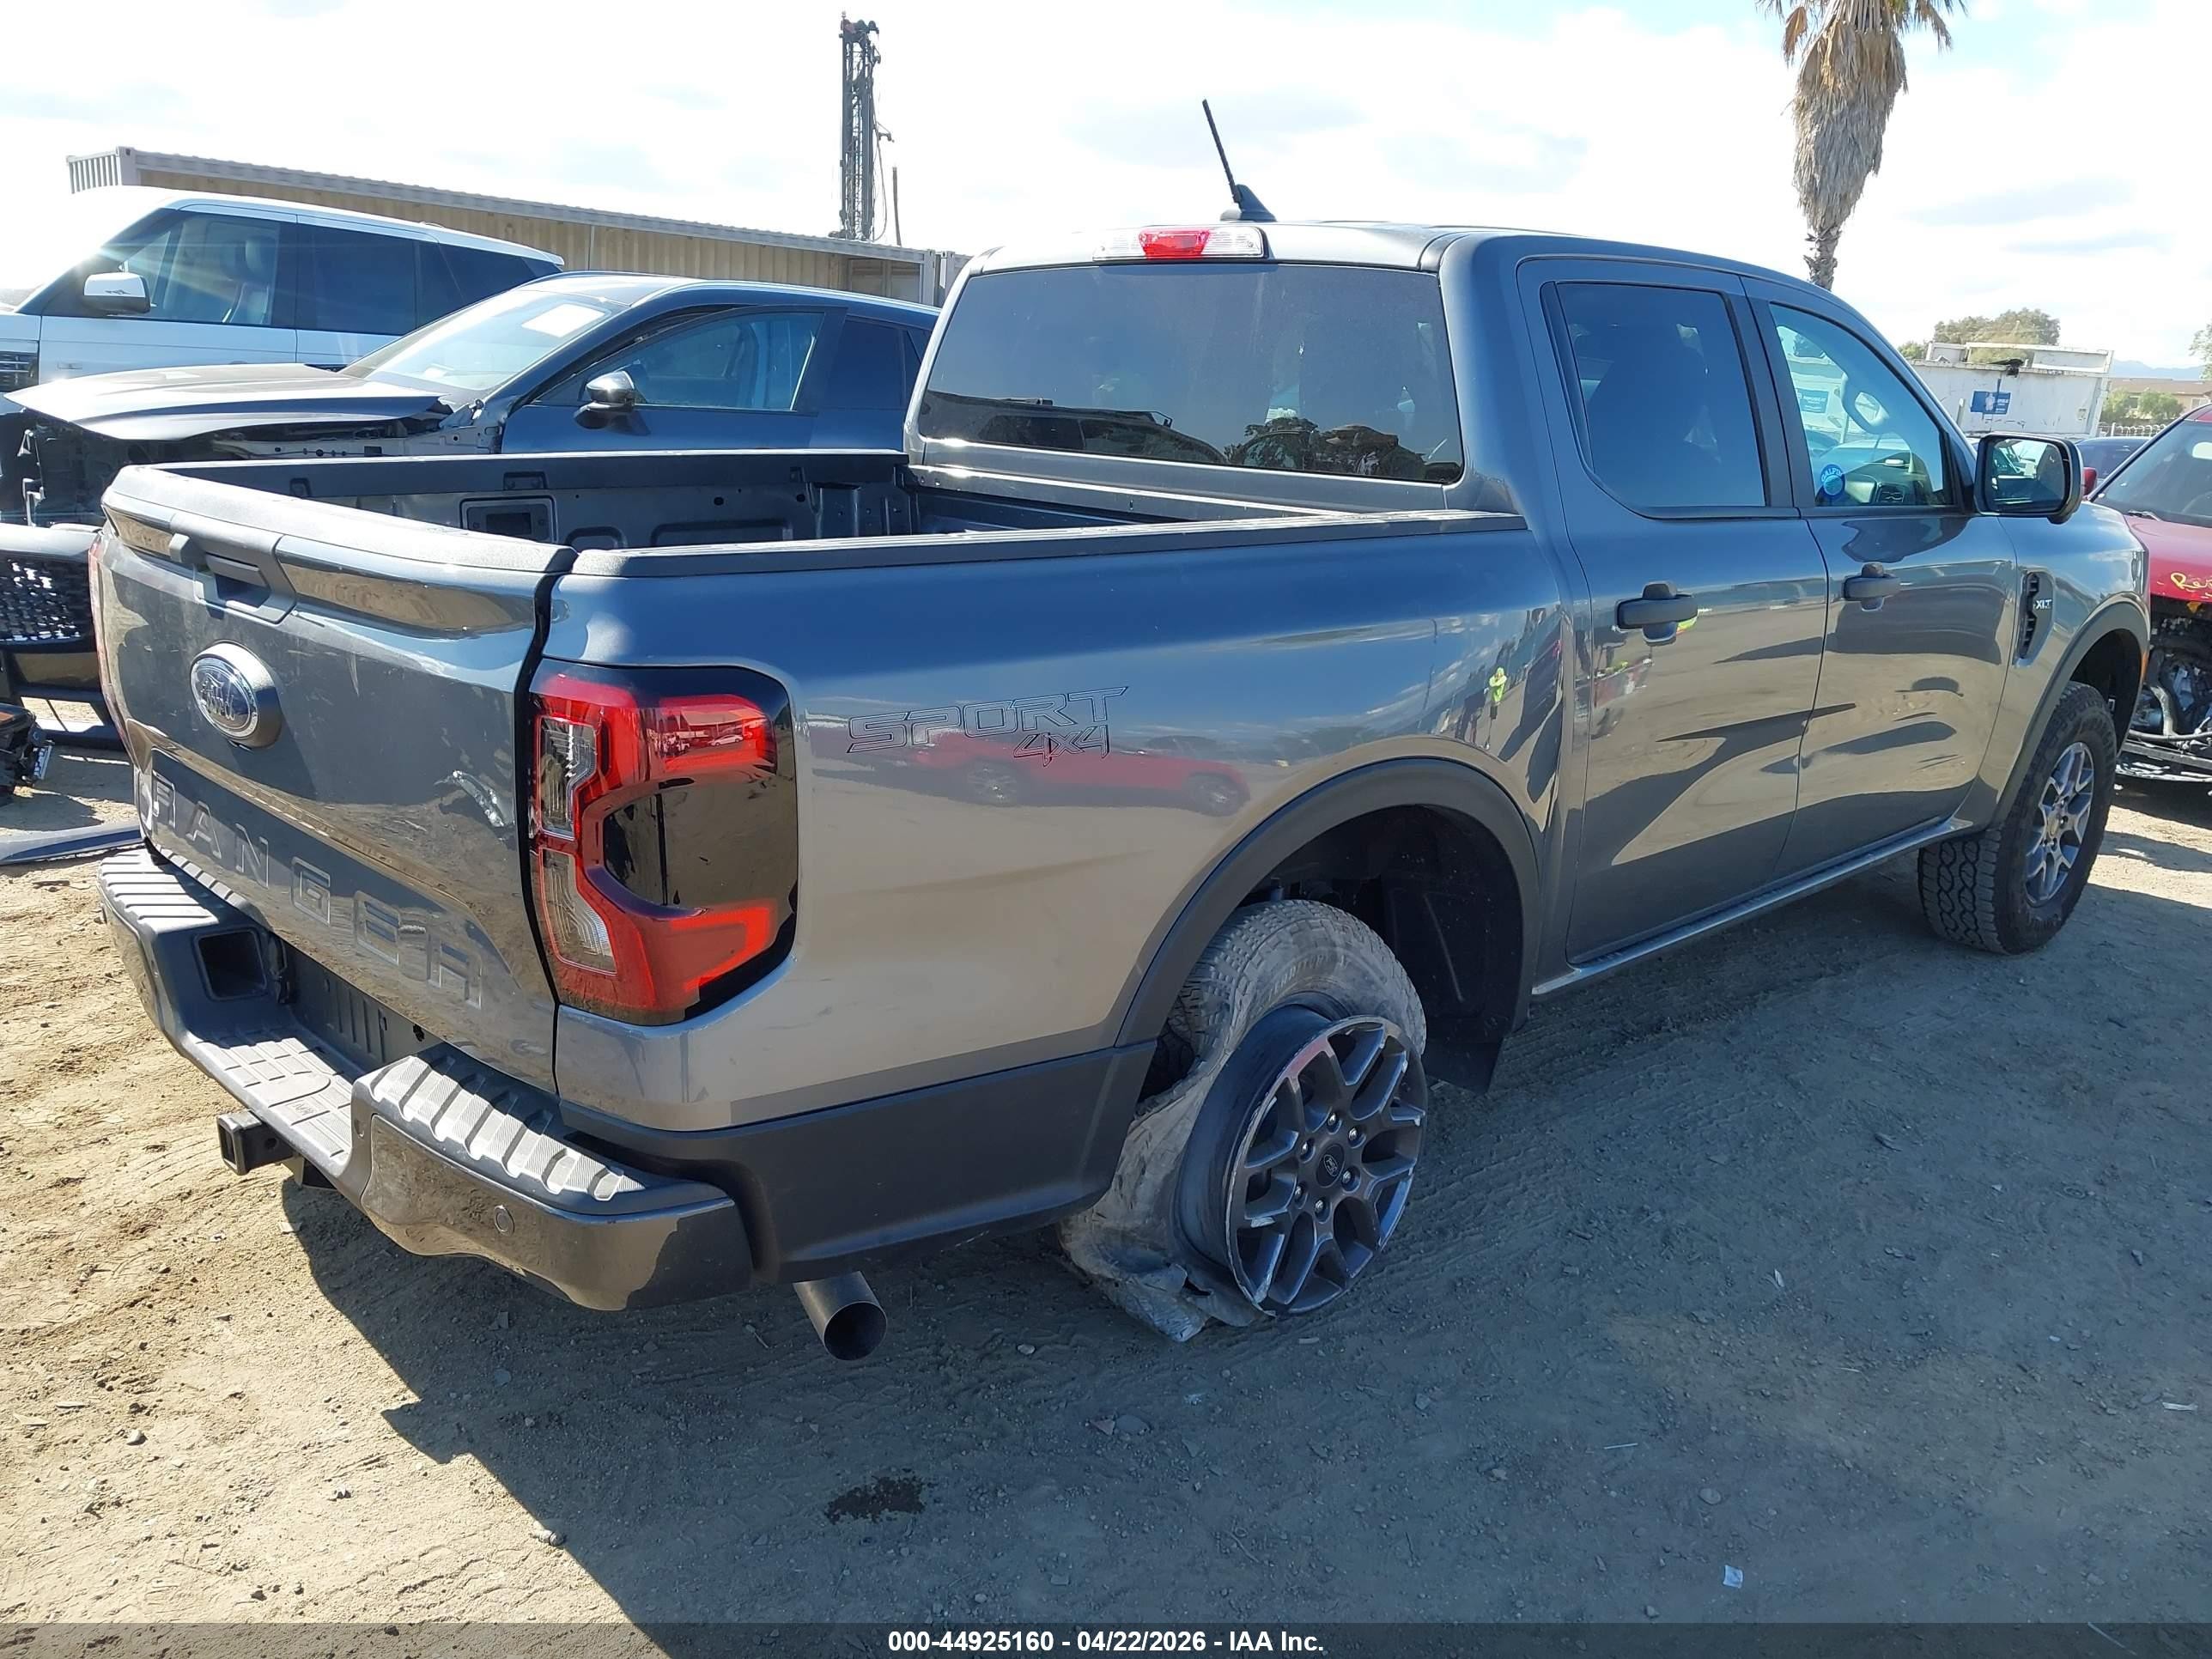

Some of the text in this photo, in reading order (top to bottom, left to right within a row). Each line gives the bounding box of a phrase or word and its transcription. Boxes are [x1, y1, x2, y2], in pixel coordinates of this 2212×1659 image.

[2035, 599, 2052, 610] XLT
[846, 685, 1129, 754] SPORT
[151, 769, 482, 1010] RANGER
